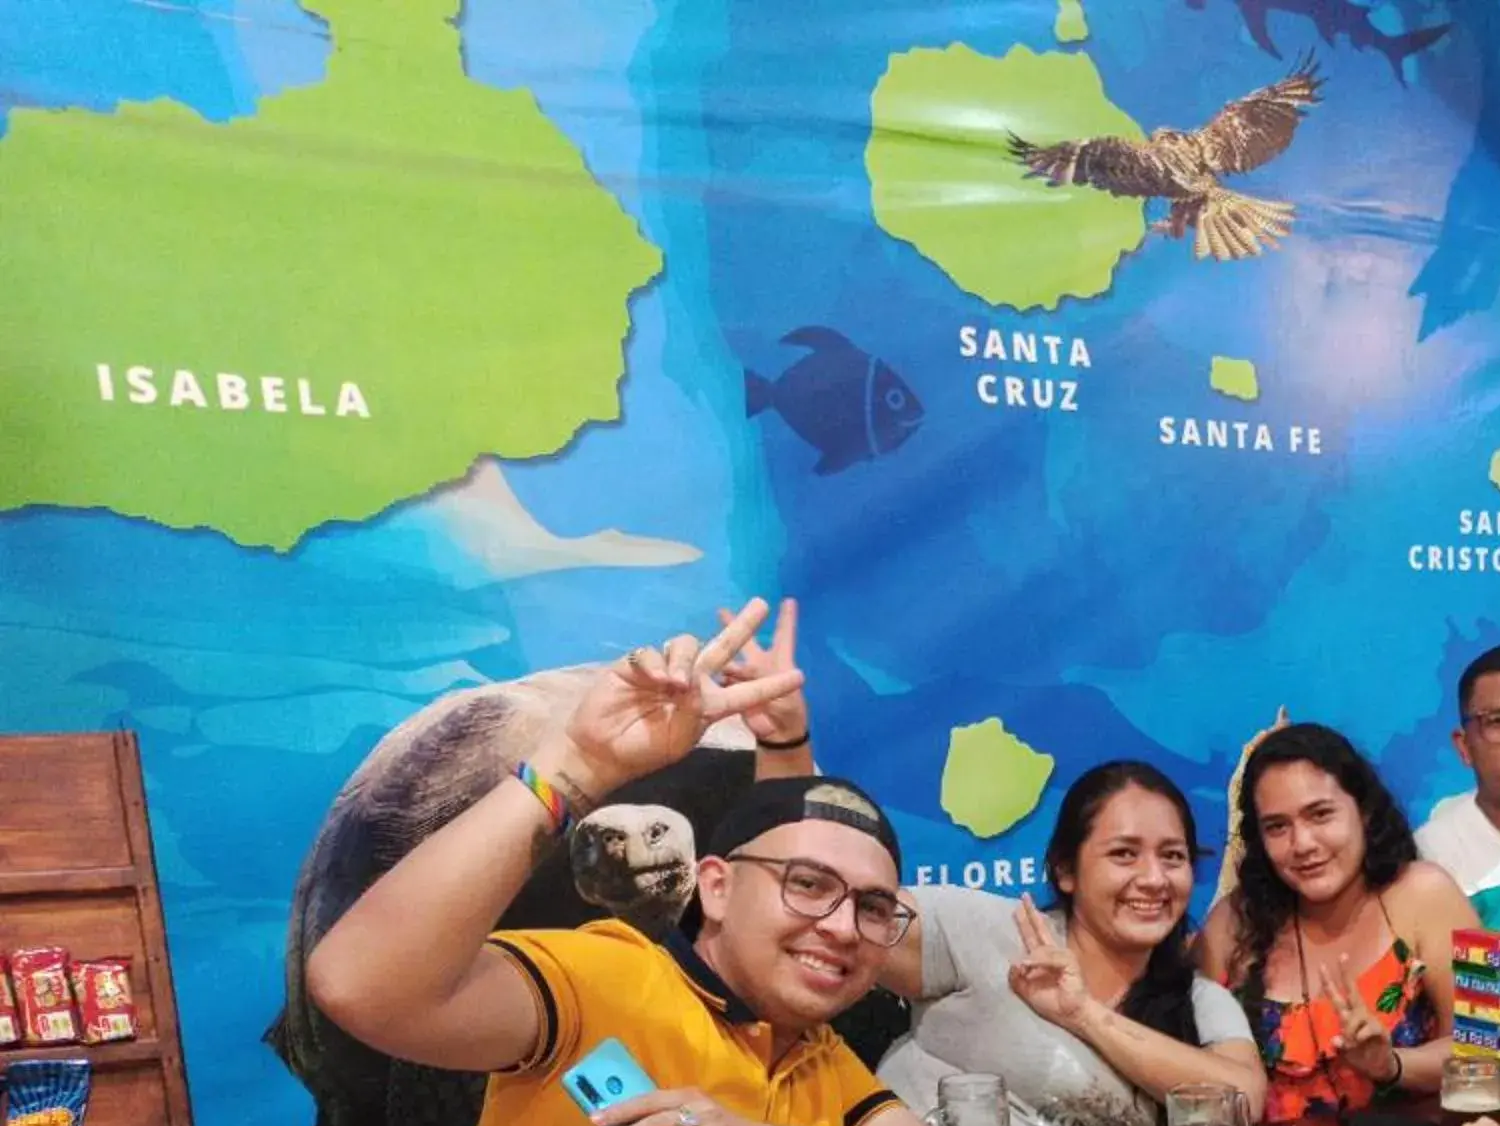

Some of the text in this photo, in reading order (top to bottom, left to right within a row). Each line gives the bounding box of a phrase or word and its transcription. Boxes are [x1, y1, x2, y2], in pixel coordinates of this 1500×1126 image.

[959, 326, 1091, 368] SANTA
[97, 363, 371, 418] ISABELA
[977, 375, 1079, 411] CRUZ
[1159, 416, 1321, 454] SANTA FE
[917, 857, 1049, 889] FLORE
